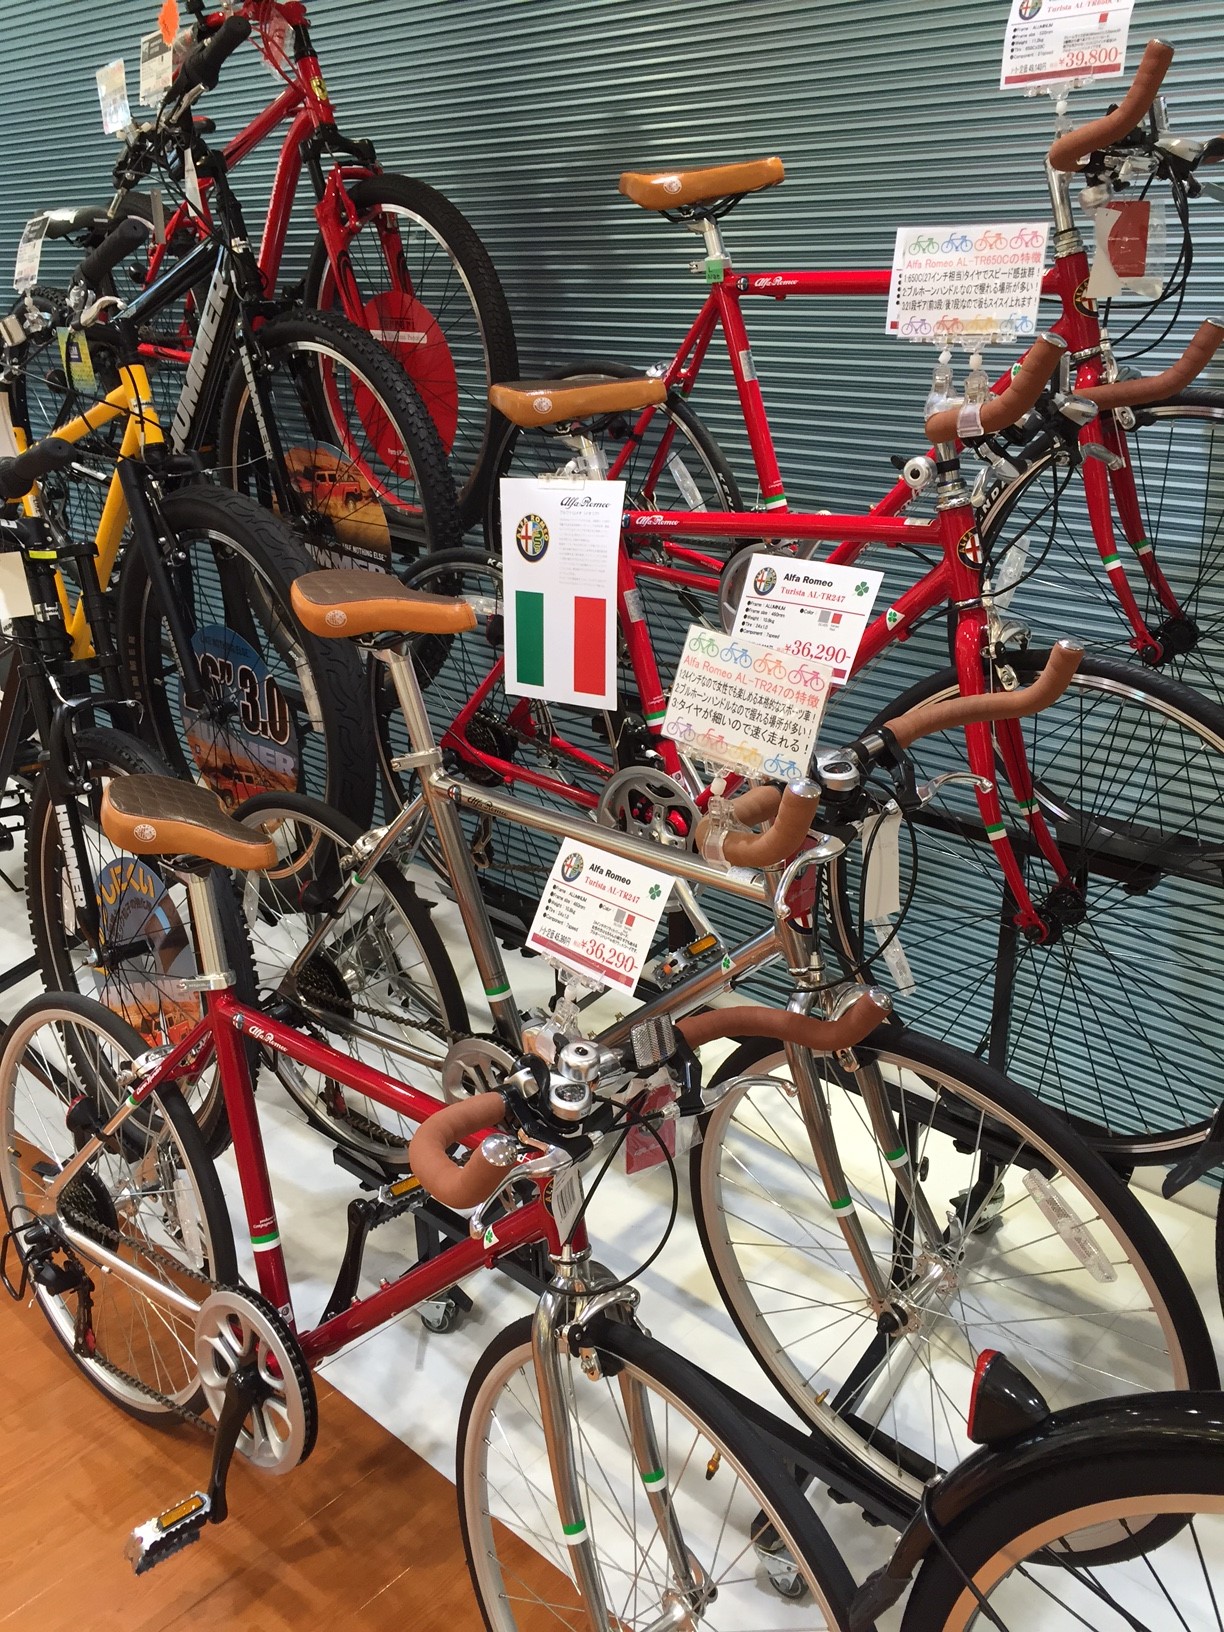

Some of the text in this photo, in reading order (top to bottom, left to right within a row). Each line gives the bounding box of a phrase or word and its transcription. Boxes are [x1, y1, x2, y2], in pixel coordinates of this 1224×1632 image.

[906, 260, 922, 269] Alfa
[925, 258, 954, 269] Romeo
[560, 495, 611, 509] Alfa Romeo
[516, 513, 550, 542] ALFA ROMEO
[783, 573, 801, 583] Alfa
[802, 575, 833, 588] Romeo
[781, 586, 846, 603] Turista AL-TR247
[785, 639, 851, 665] ¥36,290-
[683, 655, 821, 710] Alfa Romeo AL-TR247の特徴
[54, 803, 88, 910] HUMMER
[588, 863, 632, 886] Alfa Romeo
[584, 876, 641, 905] Turista AL-TR247
